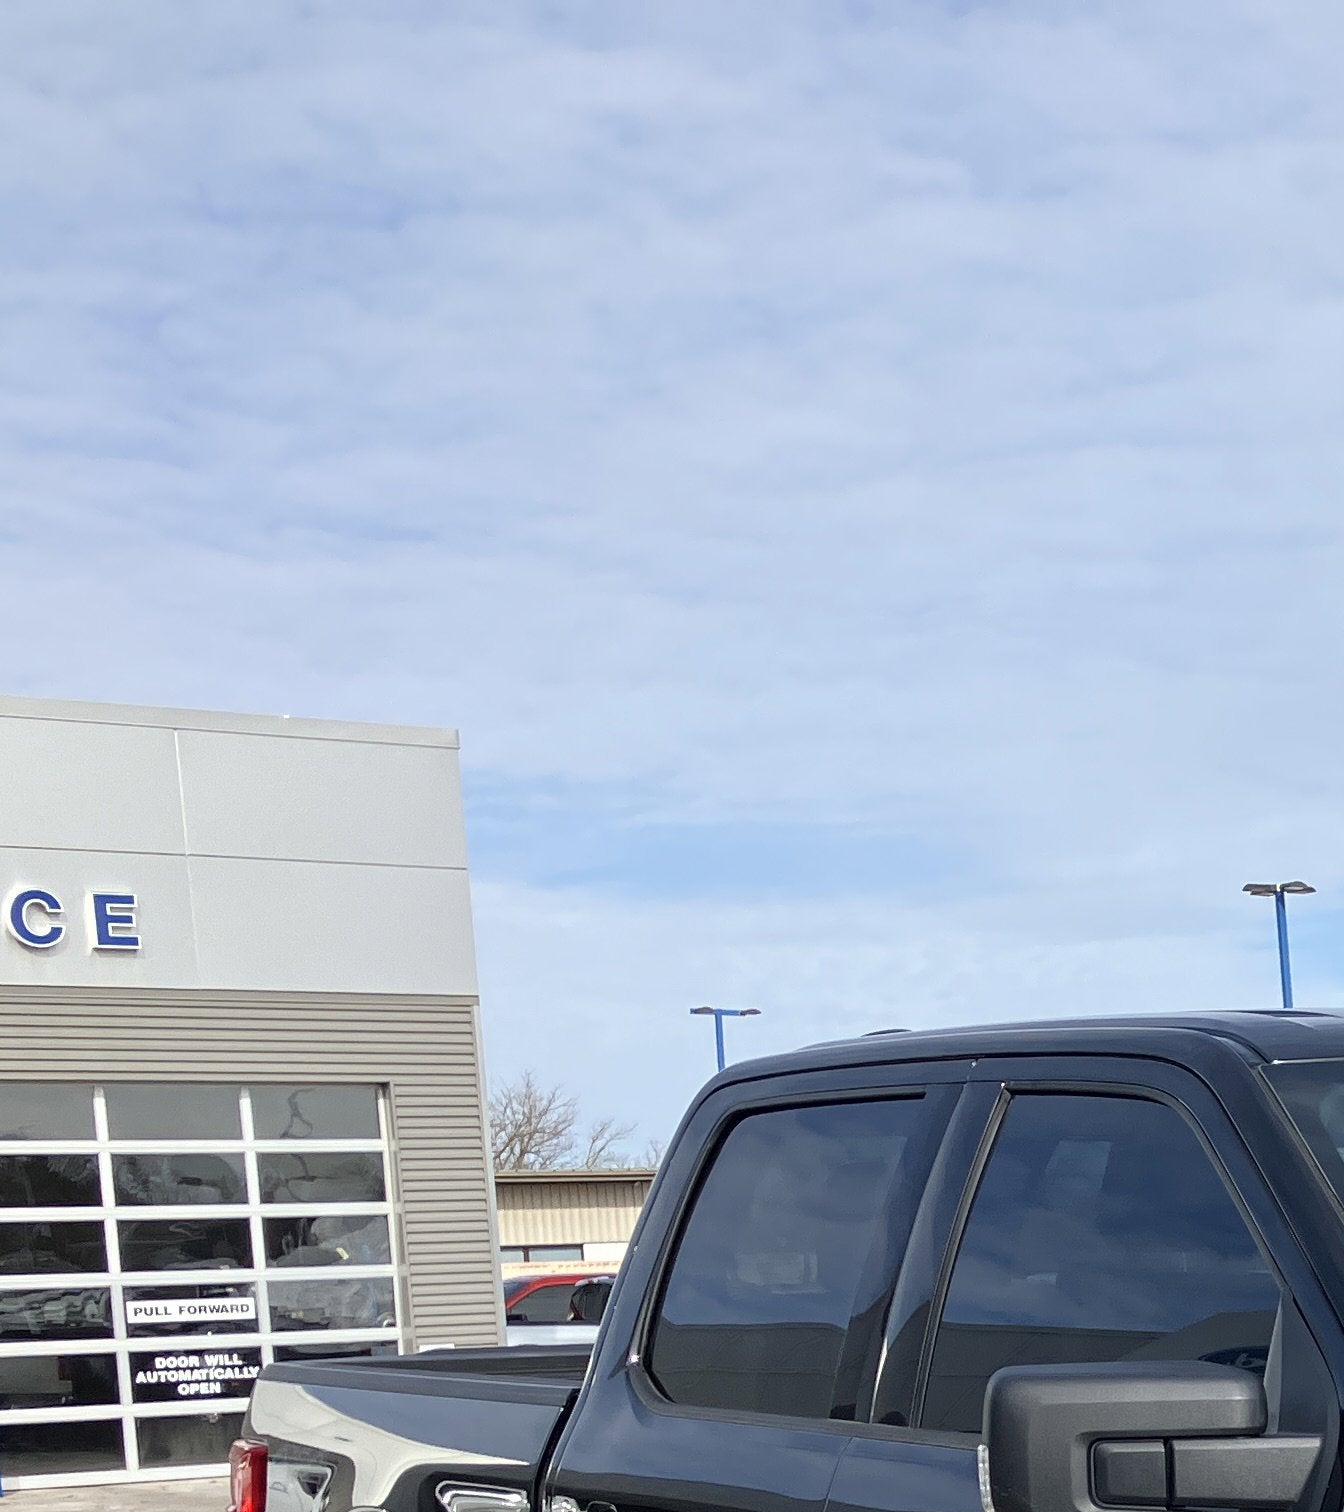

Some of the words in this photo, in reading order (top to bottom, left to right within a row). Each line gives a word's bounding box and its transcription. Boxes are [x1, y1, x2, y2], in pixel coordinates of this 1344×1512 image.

[133, 1306, 172, 1317] PULL
[178, 1304, 250, 1315] FORWARD
[154, 1356, 200, 1369] DOOR
[203, 1353, 243, 1367] WILL
[135, 1366, 260, 1384] AUTOMATICALLY
[177, 1382, 221, 1396] OPEN
